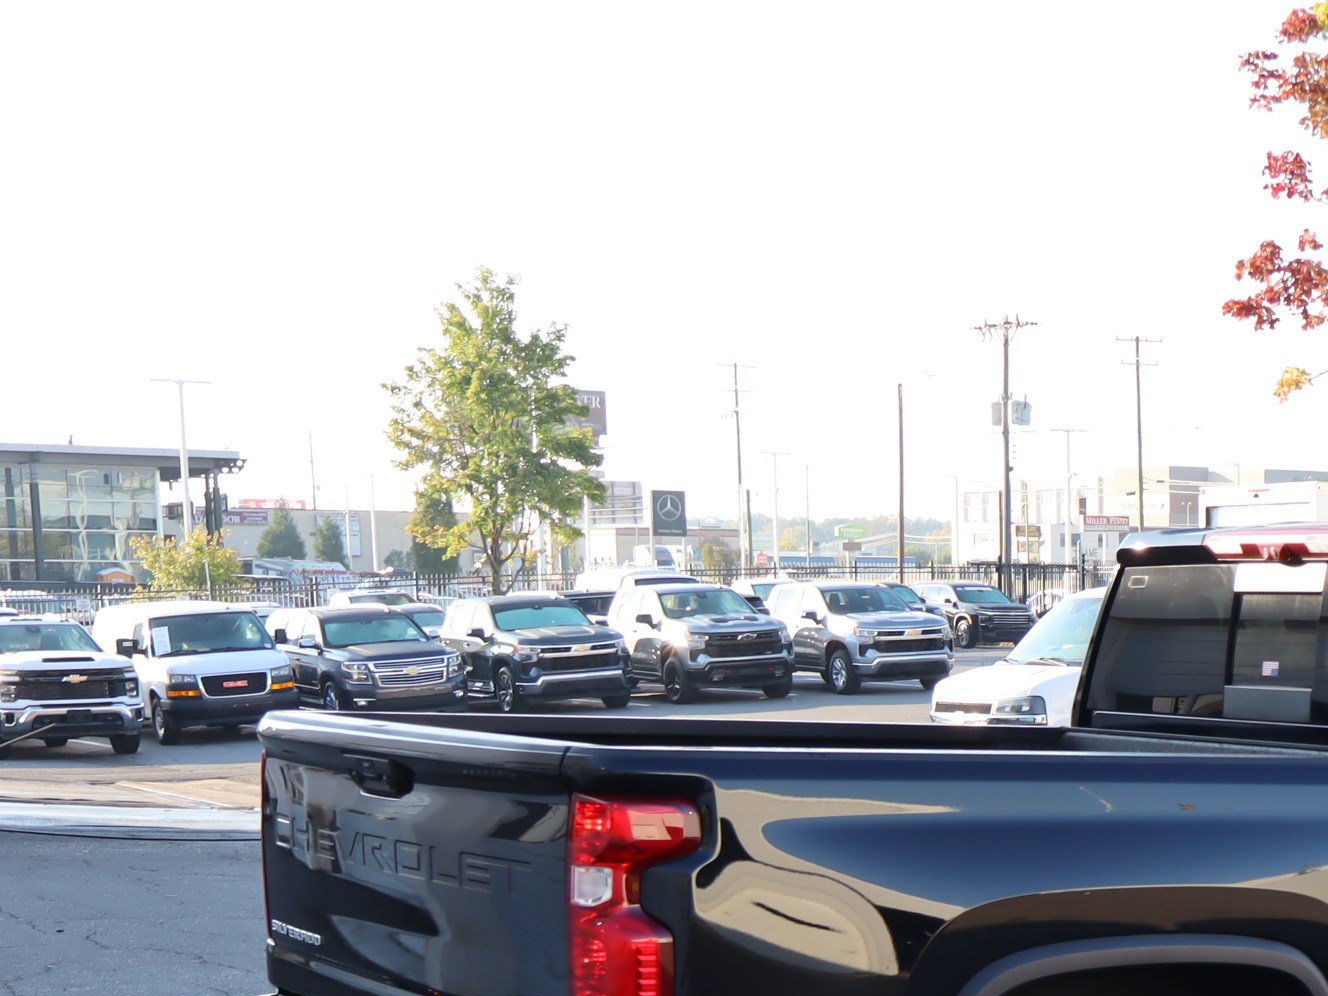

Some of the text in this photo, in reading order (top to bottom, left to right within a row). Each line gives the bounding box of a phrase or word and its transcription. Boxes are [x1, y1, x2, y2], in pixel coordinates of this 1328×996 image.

[1085, 517, 1128, 526] MILLER PIANO
[275, 815, 534, 899] CHEVROLET
[271, 919, 321, 946] SILVERADO
